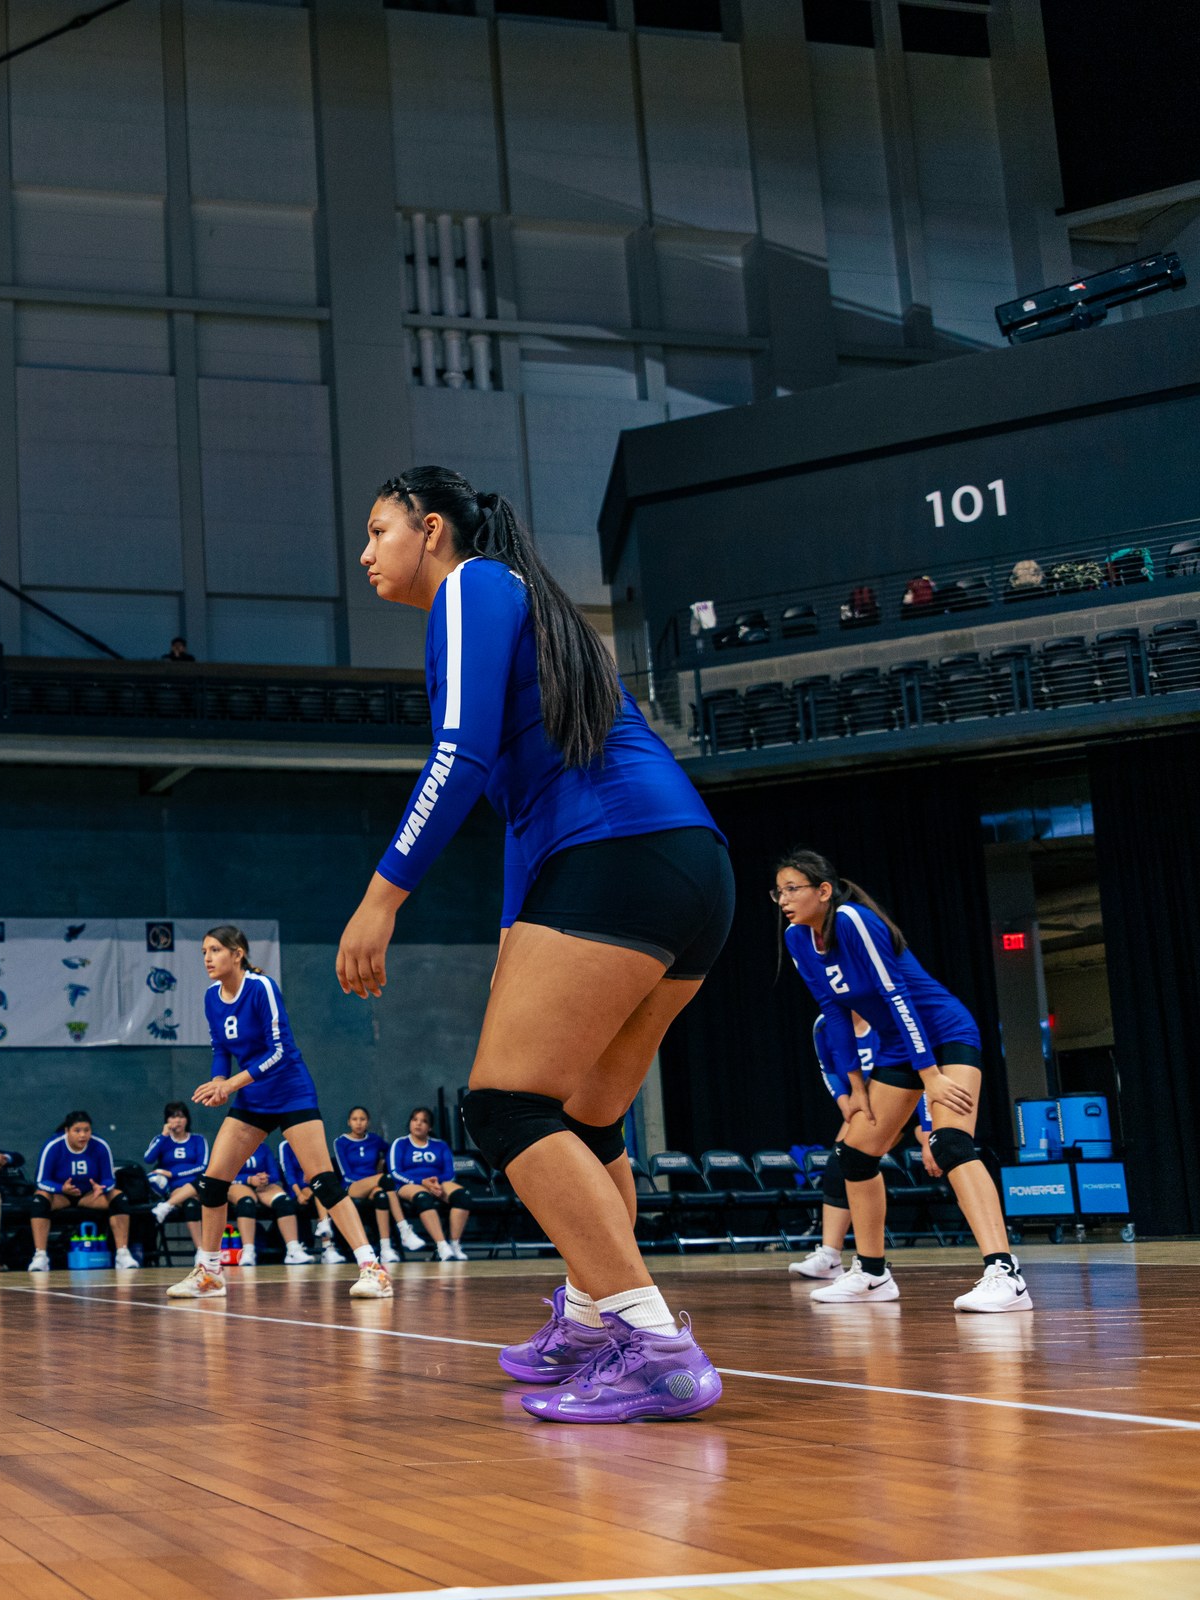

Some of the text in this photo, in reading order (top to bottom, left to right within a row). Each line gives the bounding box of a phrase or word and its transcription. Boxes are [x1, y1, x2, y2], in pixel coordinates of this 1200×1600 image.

[925, 478, 1008, 528] 101
[394, 741, 457, 856] WAKPALA
[825, 964, 850, 994] 2
[224, 1015, 238, 1040] 8
[173, 1147, 186, 1159] 6
[412, 1151, 436, 1163] 20
[71, 1160, 88, 1175] 19
